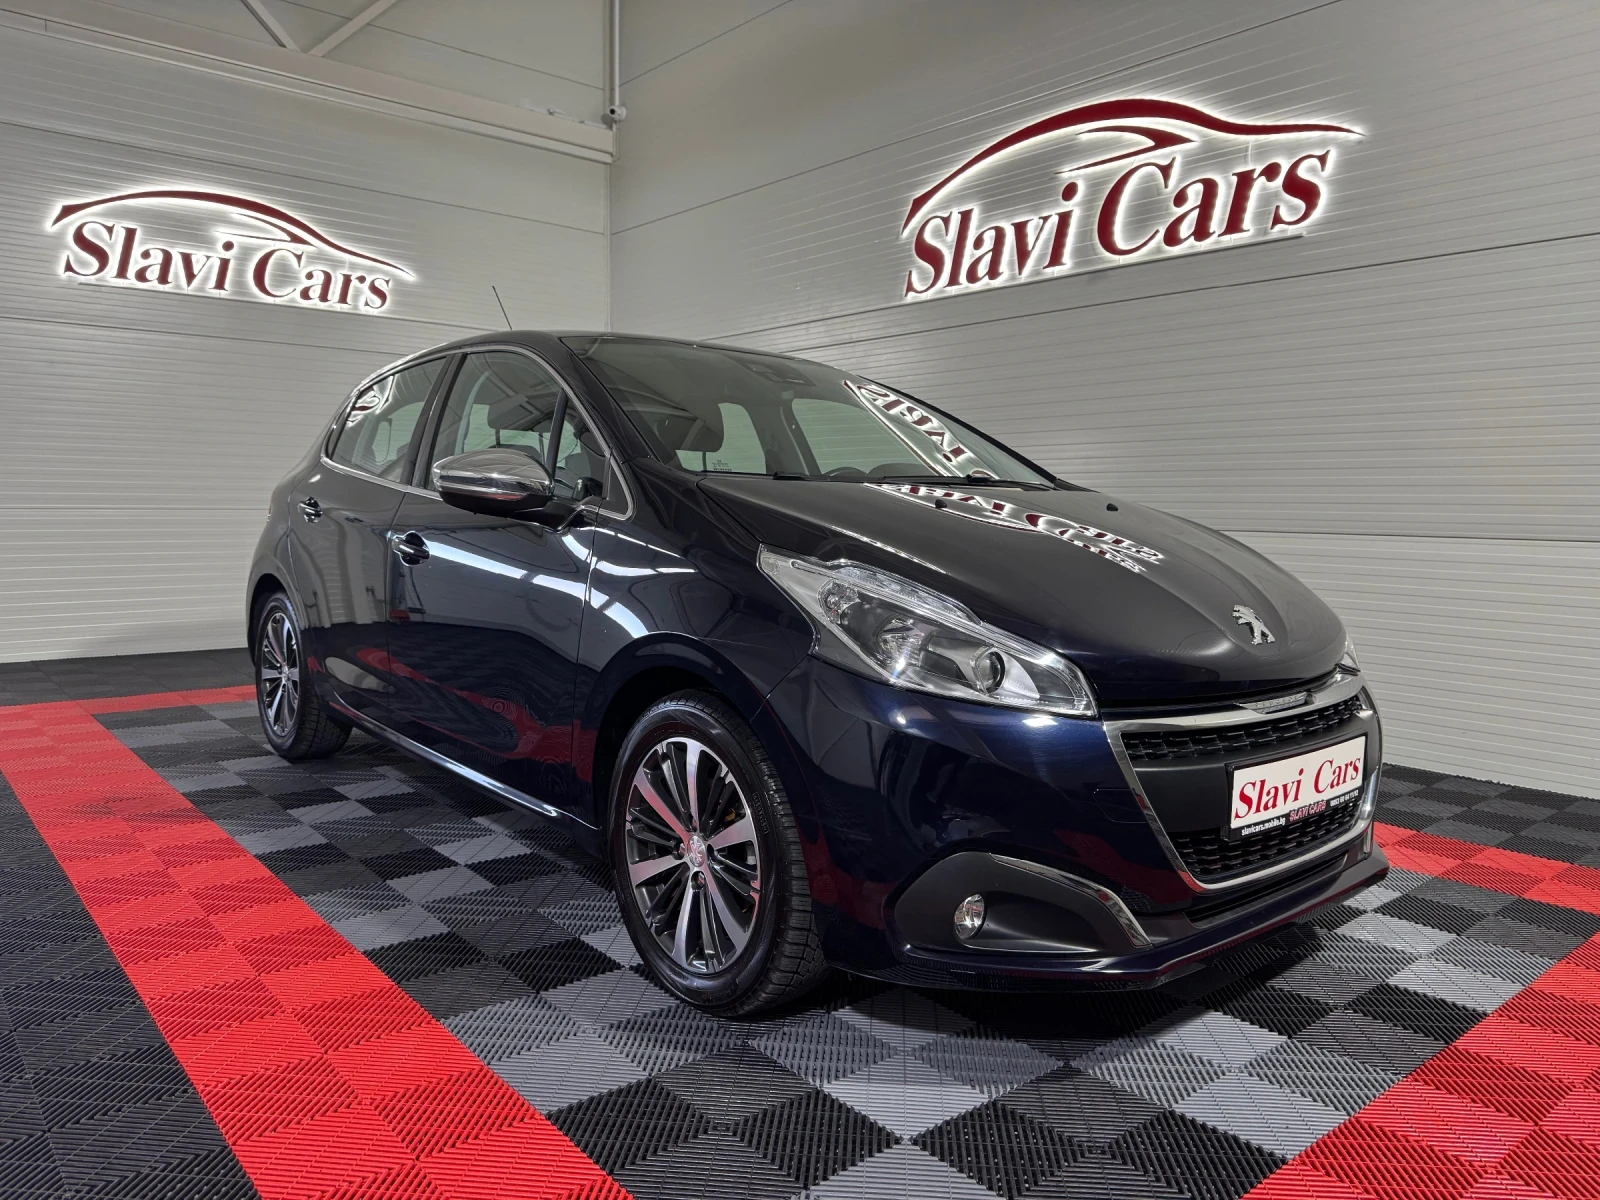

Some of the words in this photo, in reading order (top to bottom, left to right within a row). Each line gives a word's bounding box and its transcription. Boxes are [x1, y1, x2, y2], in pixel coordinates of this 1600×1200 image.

[904, 181, 1079, 298] Slavi
[1096, 149, 1332, 257] Cars
[63, 220, 235, 292] Slavi
[252, 248, 391, 310] Cars
[1234, 768, 1304, 821] Slavi
[1313, 757, 1361, 794] Cars
[1289, 807, 1309, 821] SLAVI
[1309, 801, 1326, 814] CARS
